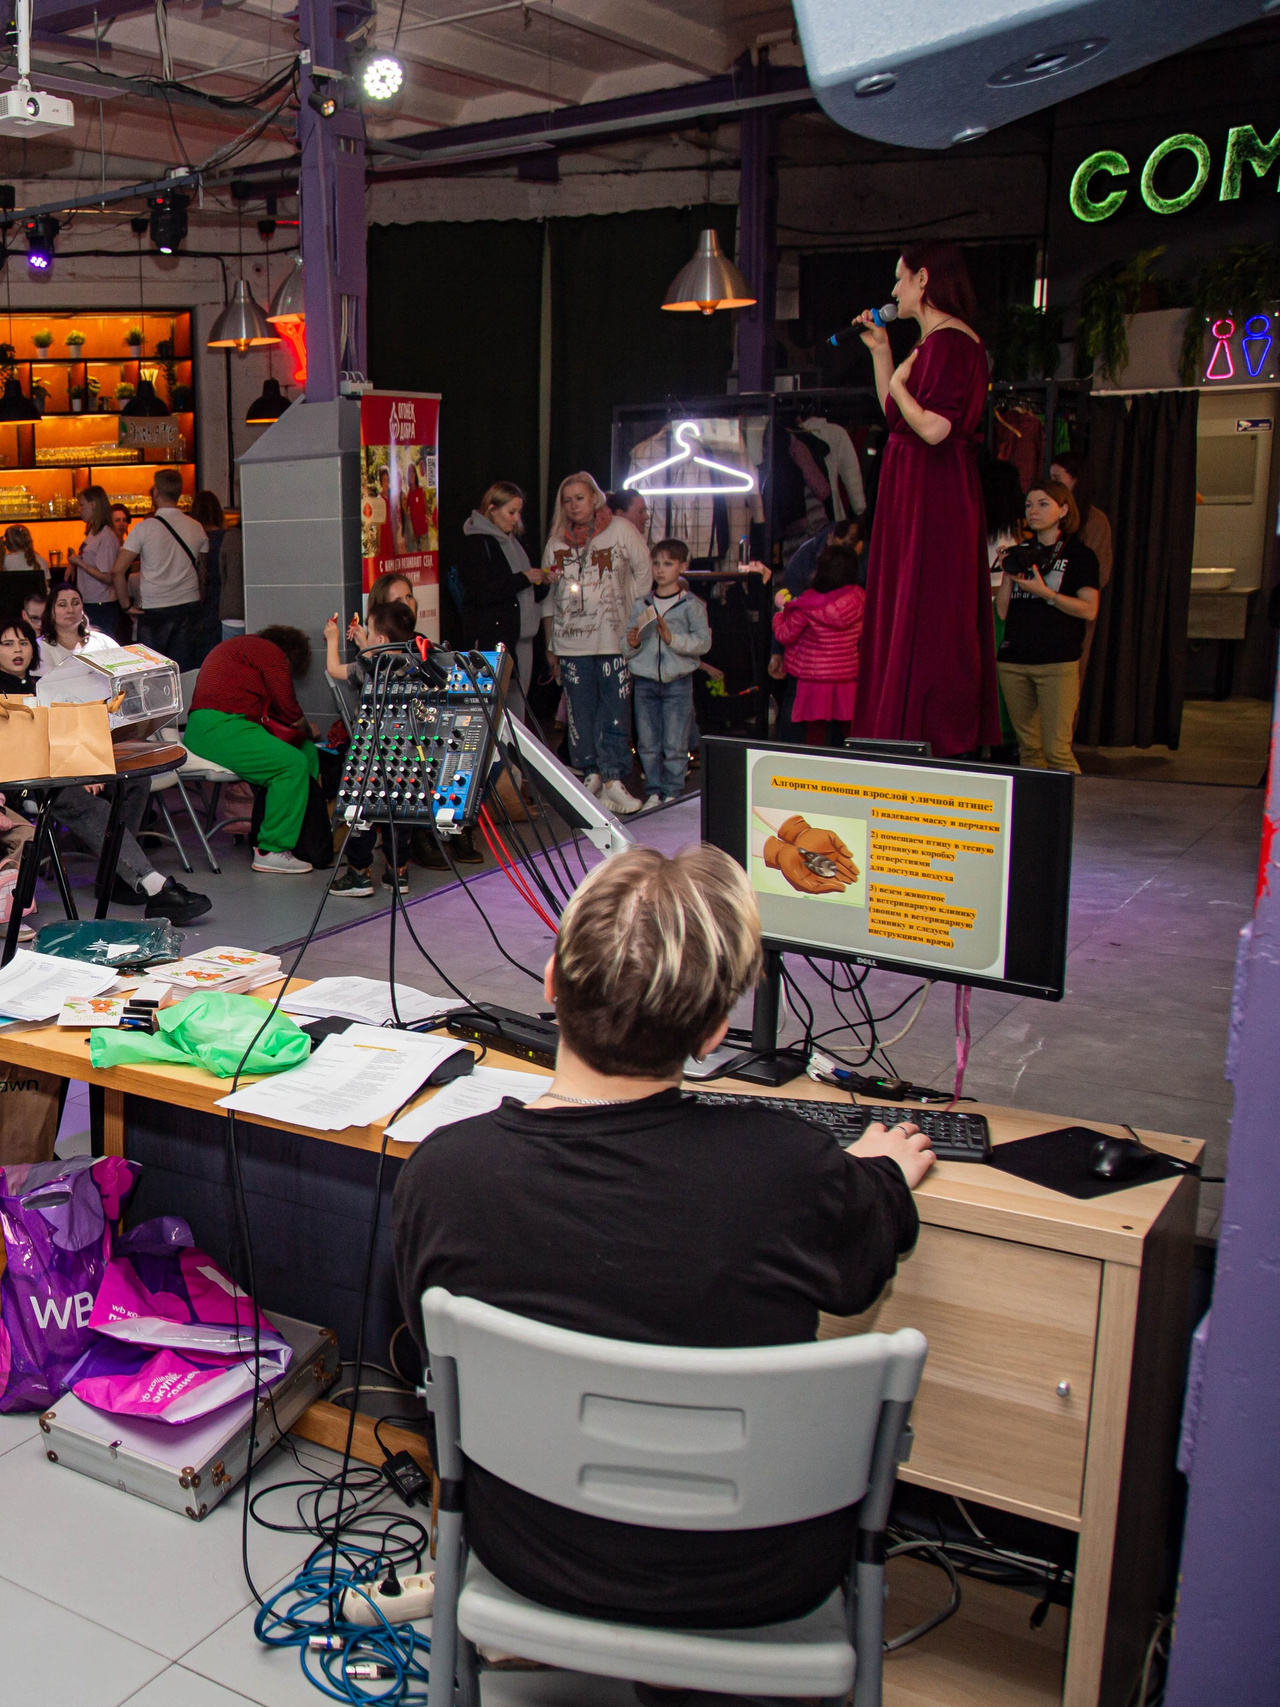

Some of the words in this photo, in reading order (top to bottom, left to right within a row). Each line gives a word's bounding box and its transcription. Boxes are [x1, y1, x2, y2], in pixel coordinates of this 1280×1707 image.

[771, 778, 818, 790] Алгоритм
[821, 785, 860, 796] помощи
[863, 790, 908, 801] взрослой
[911, 795, 955, 807] уличной
[958, 801, 993, 812] птице:
[871, 809, 879, 818] 1)
[881, 812, 920, 822] надеваем
[922, 817, 947, 827] маску
[958, 822, 1000, 832] перчатки
[870, 830, 879, 839] 2)
[880, 833, 924, 845] помещаем
[926, 839, 952, 850] птицу
[962, 845, 994, 855] тесную
[872, 843, 919, 855] картонную
[921, 850, 957, 861] коробку
[876, 854, 931, 868] отверстиями
[869, 864, 885, 872] для
[886, 866, 919, 877] доступа
[921, 871, 954, 882] воздуха
[869, 884, 878, 893] 3)
[904, 890, 946, 903] животное
[869, 906, 902, 918] (звоним
[911, 914, 973, 930] ветеринарную
[876, 897, 937, 912] ветеринарную
[938, 907, 977, 920] клинику
[870, 918, 906, 930] клинику
[916, 926, 950, 936] следуем
[868, 928, 924, 942] инструкциям
[926, 937, 954, 949] врача)
[856, 956, 878, 967] DELL
[29, 1291, 94, 1330] WB
